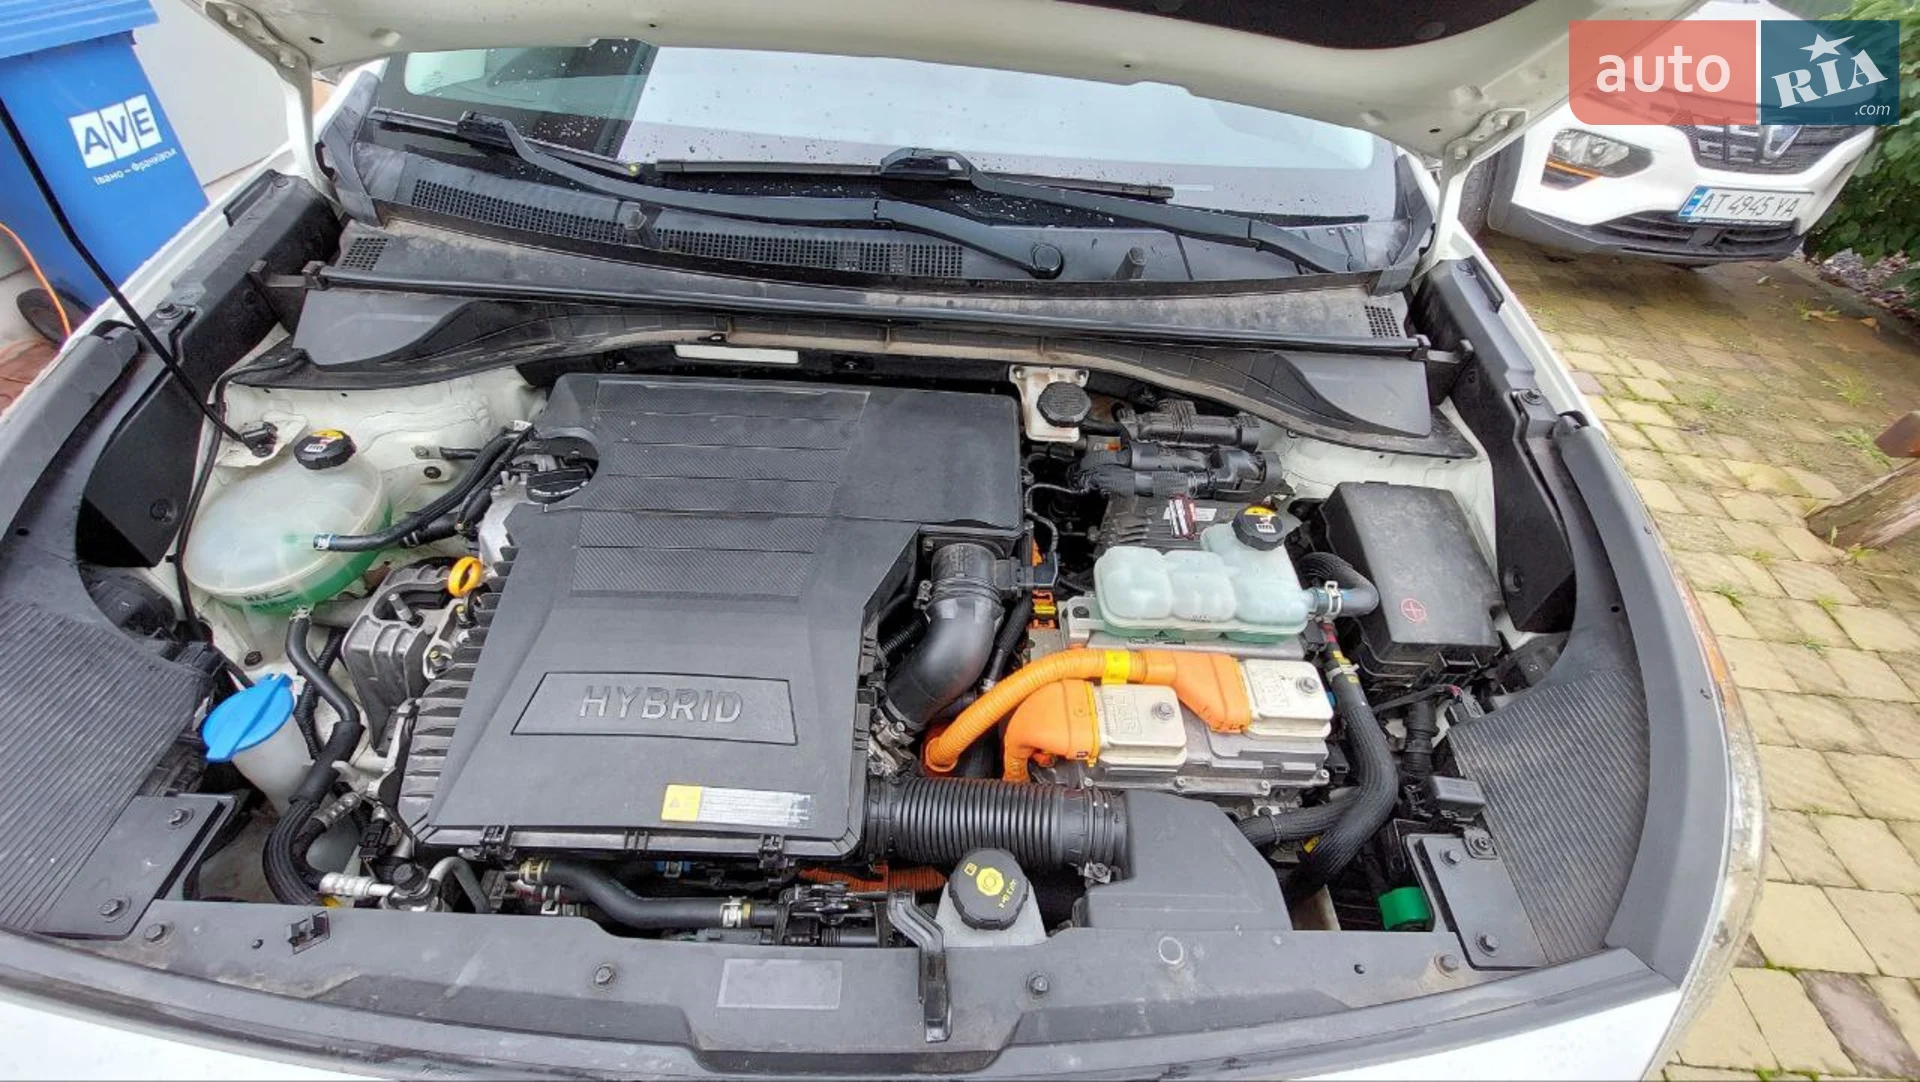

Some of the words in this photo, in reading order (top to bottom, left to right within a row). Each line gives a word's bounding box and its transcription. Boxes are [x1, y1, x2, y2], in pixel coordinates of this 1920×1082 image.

[84, 107, 154, 155] AVE
[1697, 193, 1731, 214] AT
[1728, 195, 1774, 216] 4945
[1772, 197, 1801, 217] YA
[577, 684, 744, 724] HYBRID
